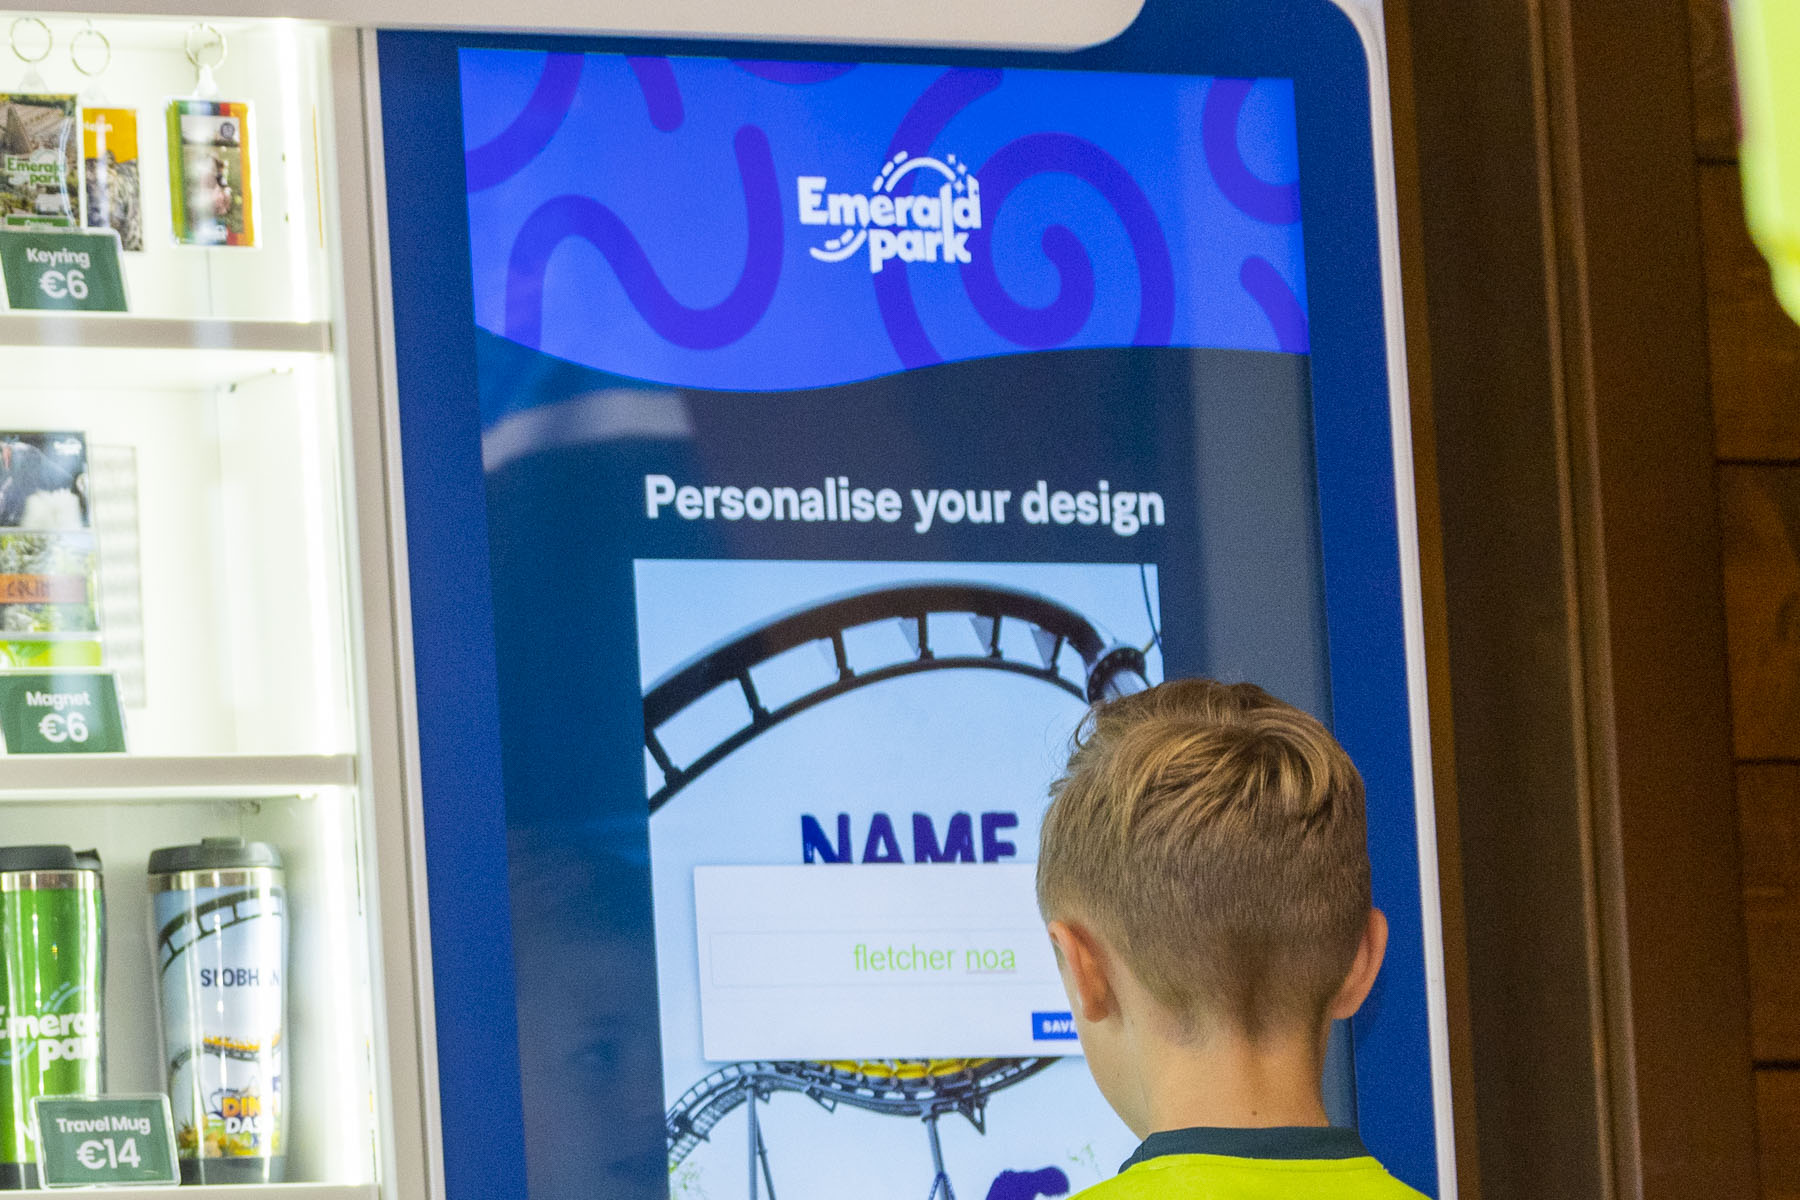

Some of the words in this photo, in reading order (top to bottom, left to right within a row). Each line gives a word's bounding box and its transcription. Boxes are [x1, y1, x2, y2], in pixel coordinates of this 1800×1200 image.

[799, 171, 982, 229] Emerald
[26, 247, 91, 270] Keyring
[39, 269, 89, 300] €6
[645, 474, 902, 525] Personalise
[913, 488, 1011, 532] your
[1022, 480, 1165, 537] design
[26, 690, 91, 710] Magnet
[38, 712, 89, 743] €6
[853, 943, 955, 972] fletcher
[965, 950, 1017, 972] noa
[56, 1115, 111, 1135] Travel
[112, 1115, 151, 1136] Mug
[76, 1138, 141, 1170] €14
